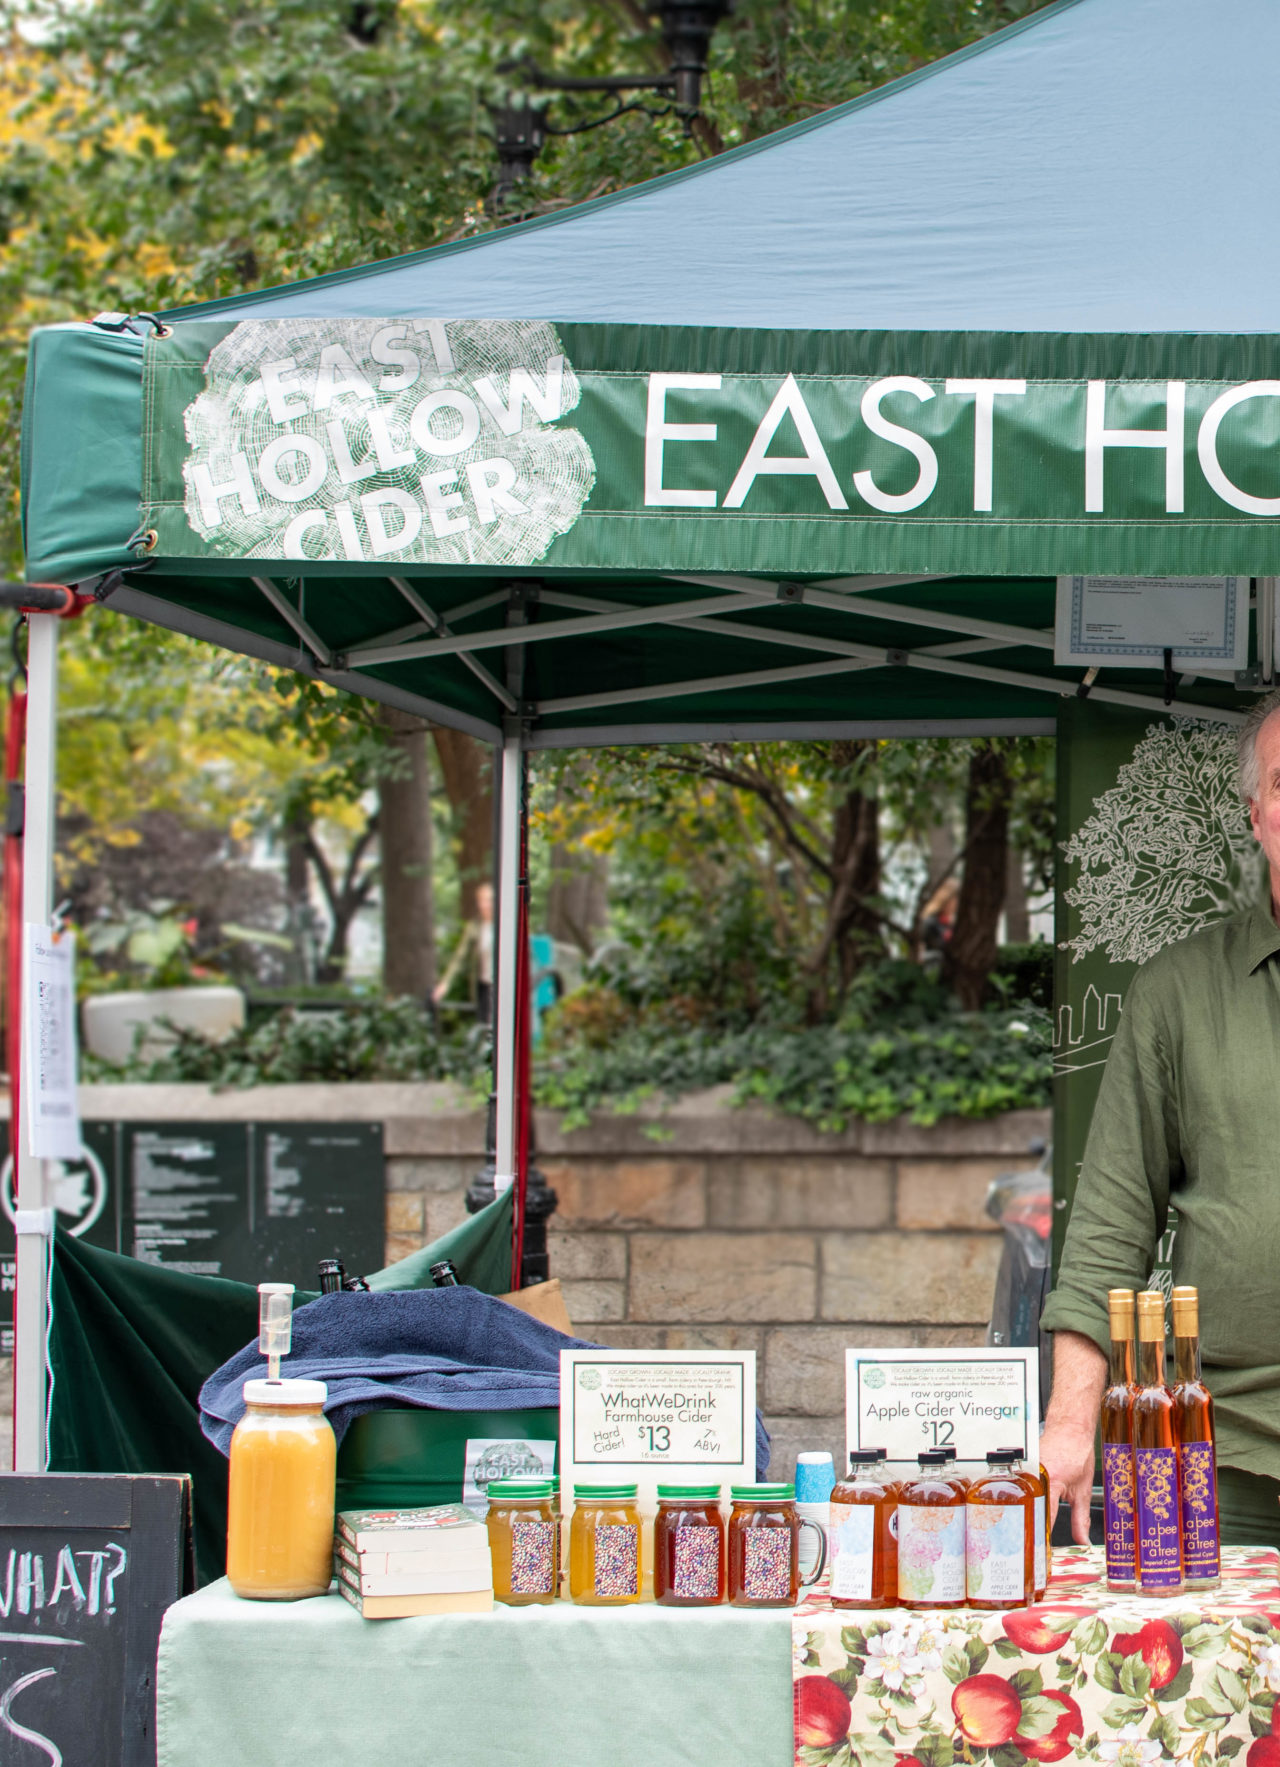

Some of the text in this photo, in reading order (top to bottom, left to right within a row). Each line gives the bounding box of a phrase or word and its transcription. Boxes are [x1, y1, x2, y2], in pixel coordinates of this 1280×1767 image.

[260, 320, 457, 424] EAST
[191, 354, 565, 528] HOLLOW
[645, 372, 1026, 513] EAST
[283, 457, 533, 561] CIDER
[600, 1391, 717, 1409] WhatWeDrink
[933, 1388, 973, 1401] organic
[605, 1409, 713, 1423] Farmhouse Cider
[866, 1401, 1019, 1422] Apple Cider Vinegar
[593, 1426, 621, 1441] Hard
[638, 1425, 671, 1452] $13
[921, 1420, 955, 1446] $12
[593, 1438, 625, 1454] Cider!
[491, 1454, 529, 1466] EAST
[475, 1466, 543, 1479] HOLLOW
[1121, 1518, 1136, 1530] be
[1186, 1517, 1215, 1528] a bee
[1148, 1523, 1178, 1536] a bee
[1107, 1532, 1124, 1541] and
[1141, 1538, 1161, 1548] and
[1121, 1541, 1136, 1551] tre
[1188, 1539, 1215, 1550] a tree
[1149, 1547, 1178, 1557] a tree
